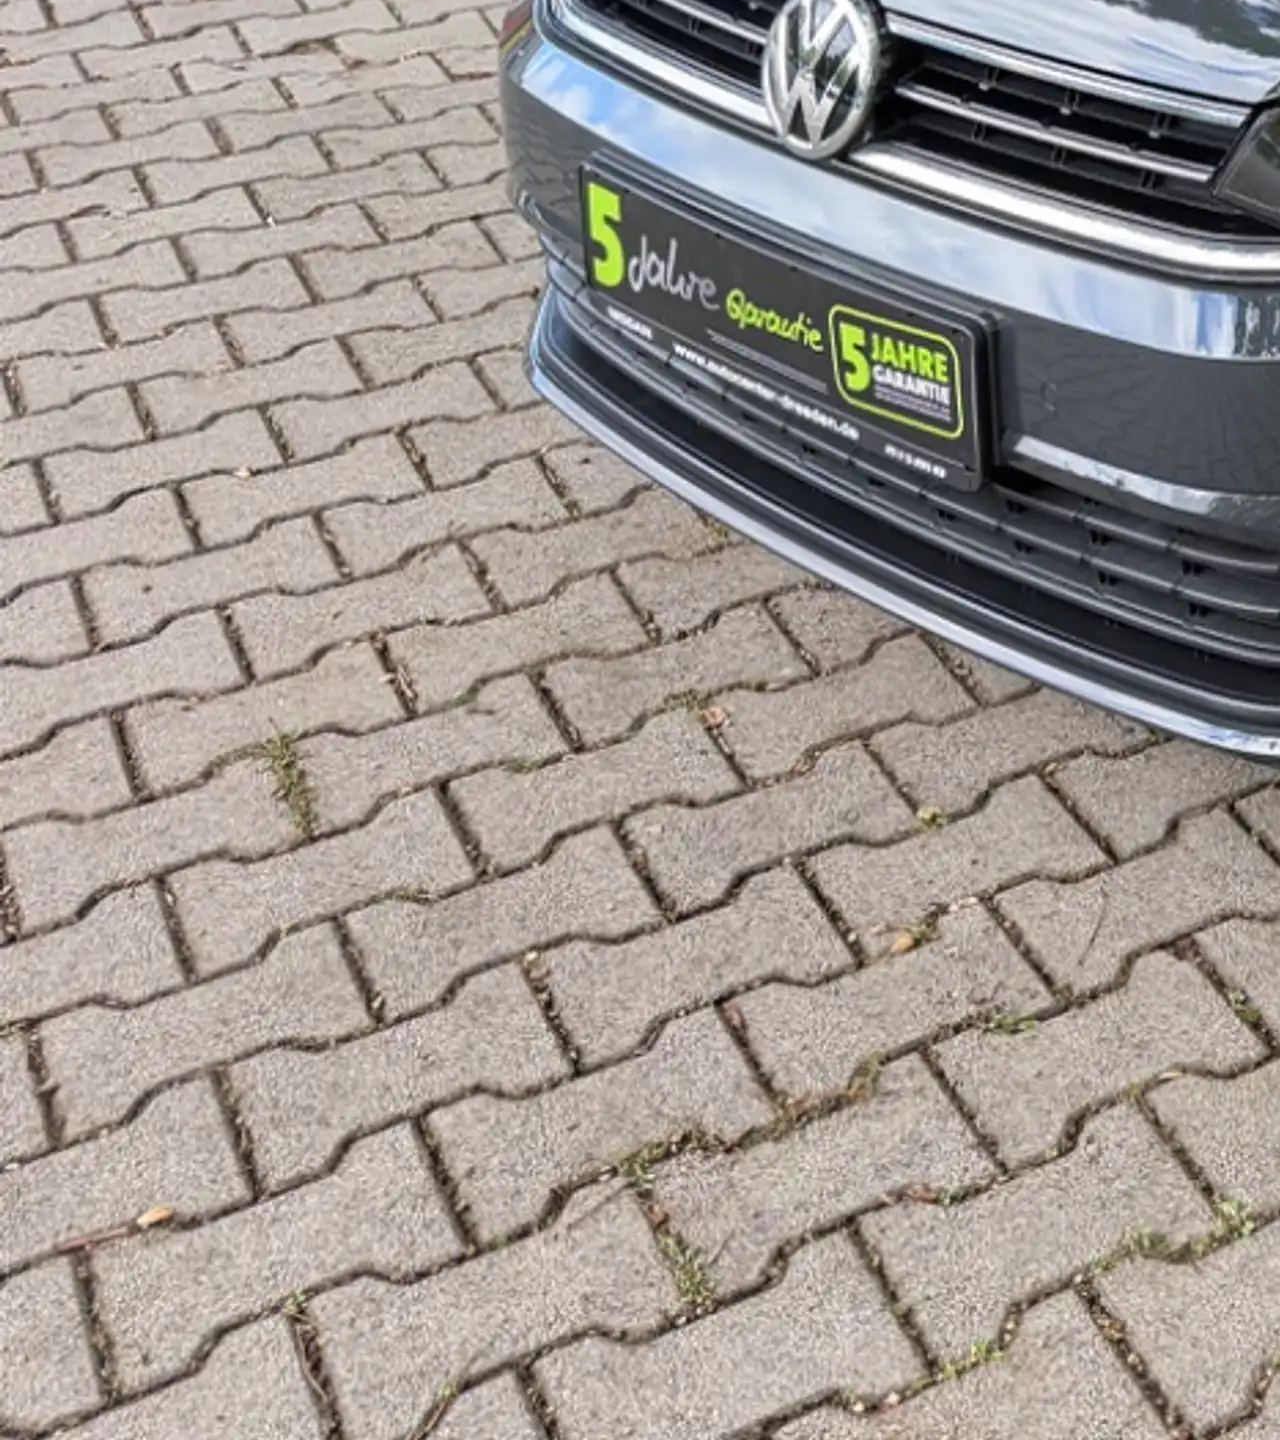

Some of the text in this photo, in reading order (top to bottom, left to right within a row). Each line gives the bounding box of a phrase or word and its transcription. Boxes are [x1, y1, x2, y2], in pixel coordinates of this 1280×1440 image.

[587, 181, 625, 288] 5
[839, 322, 872, 392] 5
[871, 332, 949, 384] JAHRE
